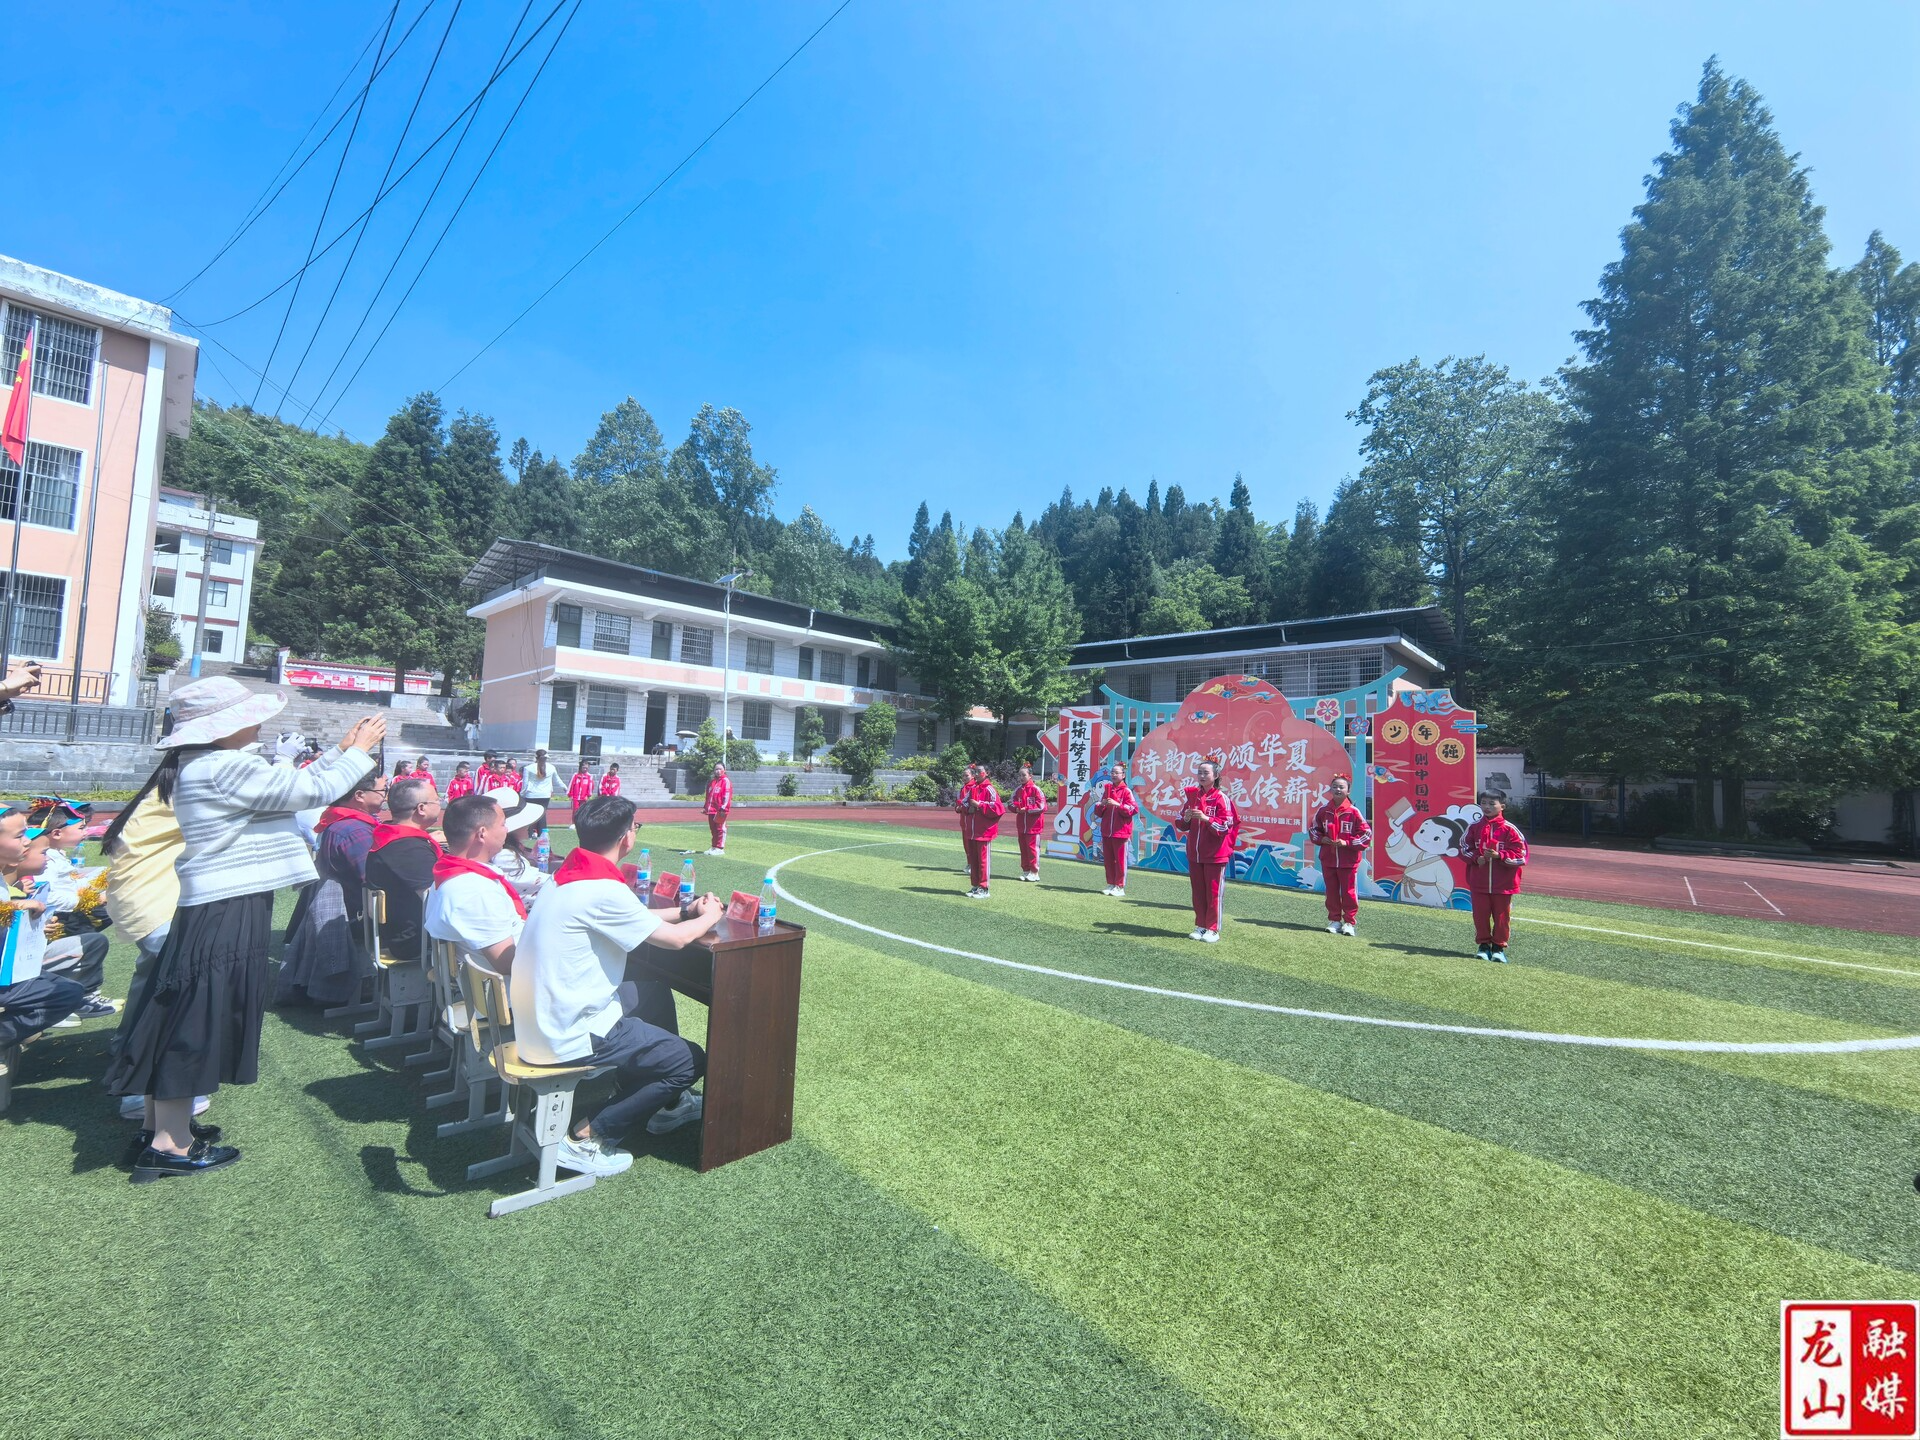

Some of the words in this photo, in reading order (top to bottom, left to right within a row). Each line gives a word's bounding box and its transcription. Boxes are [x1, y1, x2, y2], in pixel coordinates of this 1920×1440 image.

[1069, 719, 1090, 804] 筑梦童年
[1389, 724, 1459, 759] 少年强
[1150, 772, 1332, 820] 红歌亮传薪火
[1414, 752, 1430, 813] 则中国强
